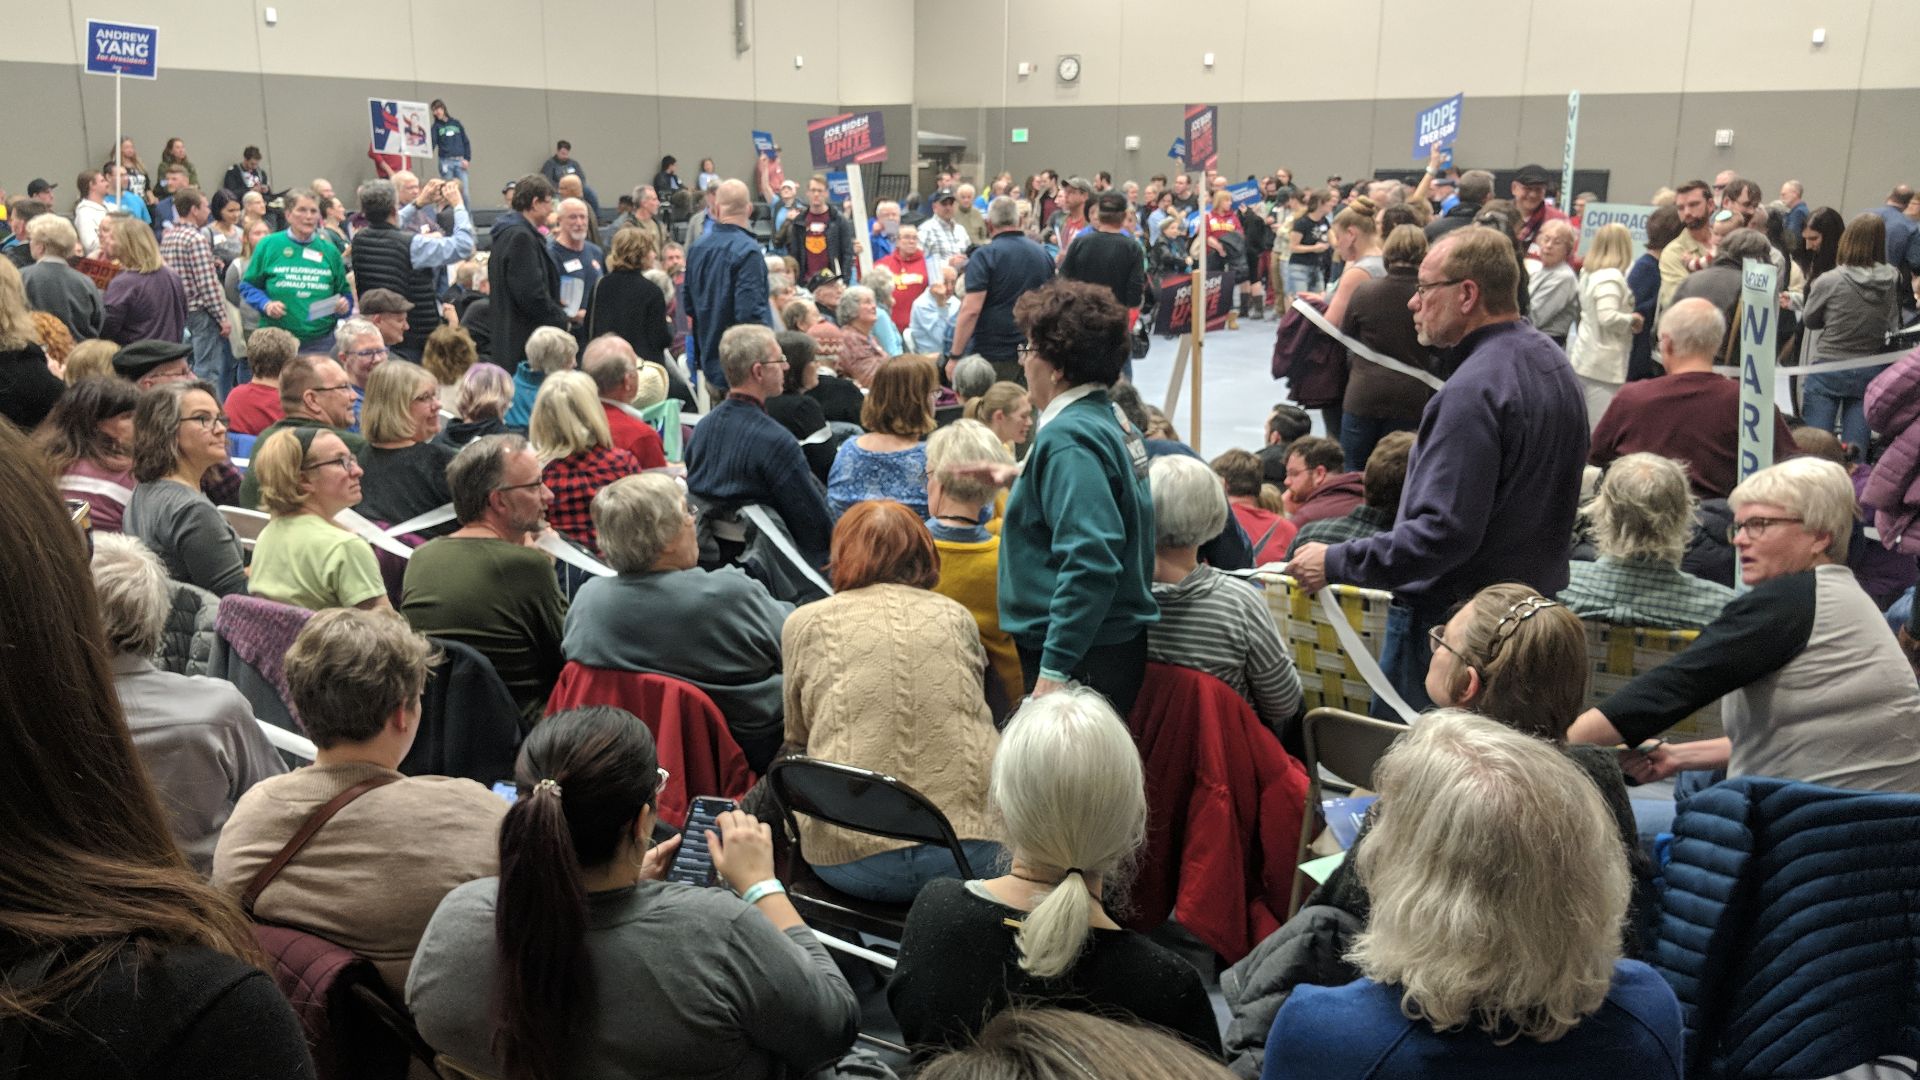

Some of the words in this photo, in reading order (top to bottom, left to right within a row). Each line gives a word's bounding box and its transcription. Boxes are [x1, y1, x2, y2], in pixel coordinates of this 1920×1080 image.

[96, 28, 149, 43] ANDREW
[96, 38, 149, 58] YANG
[1421, 99, 1458, 134] HOPE
[824, 126, 842, 139] JOE
[841, 115, 869, 132] BIDEN
[825, 130, 872, 157] UNITE
[1419, 129, 1439, 146] OVER
[1586, 211, 1650, 230] COURAG
[275, 280, 305, 289] DONALD
[302, 275, 320, 283] BEAT
[1742, 303, 1769, 479] WARR
